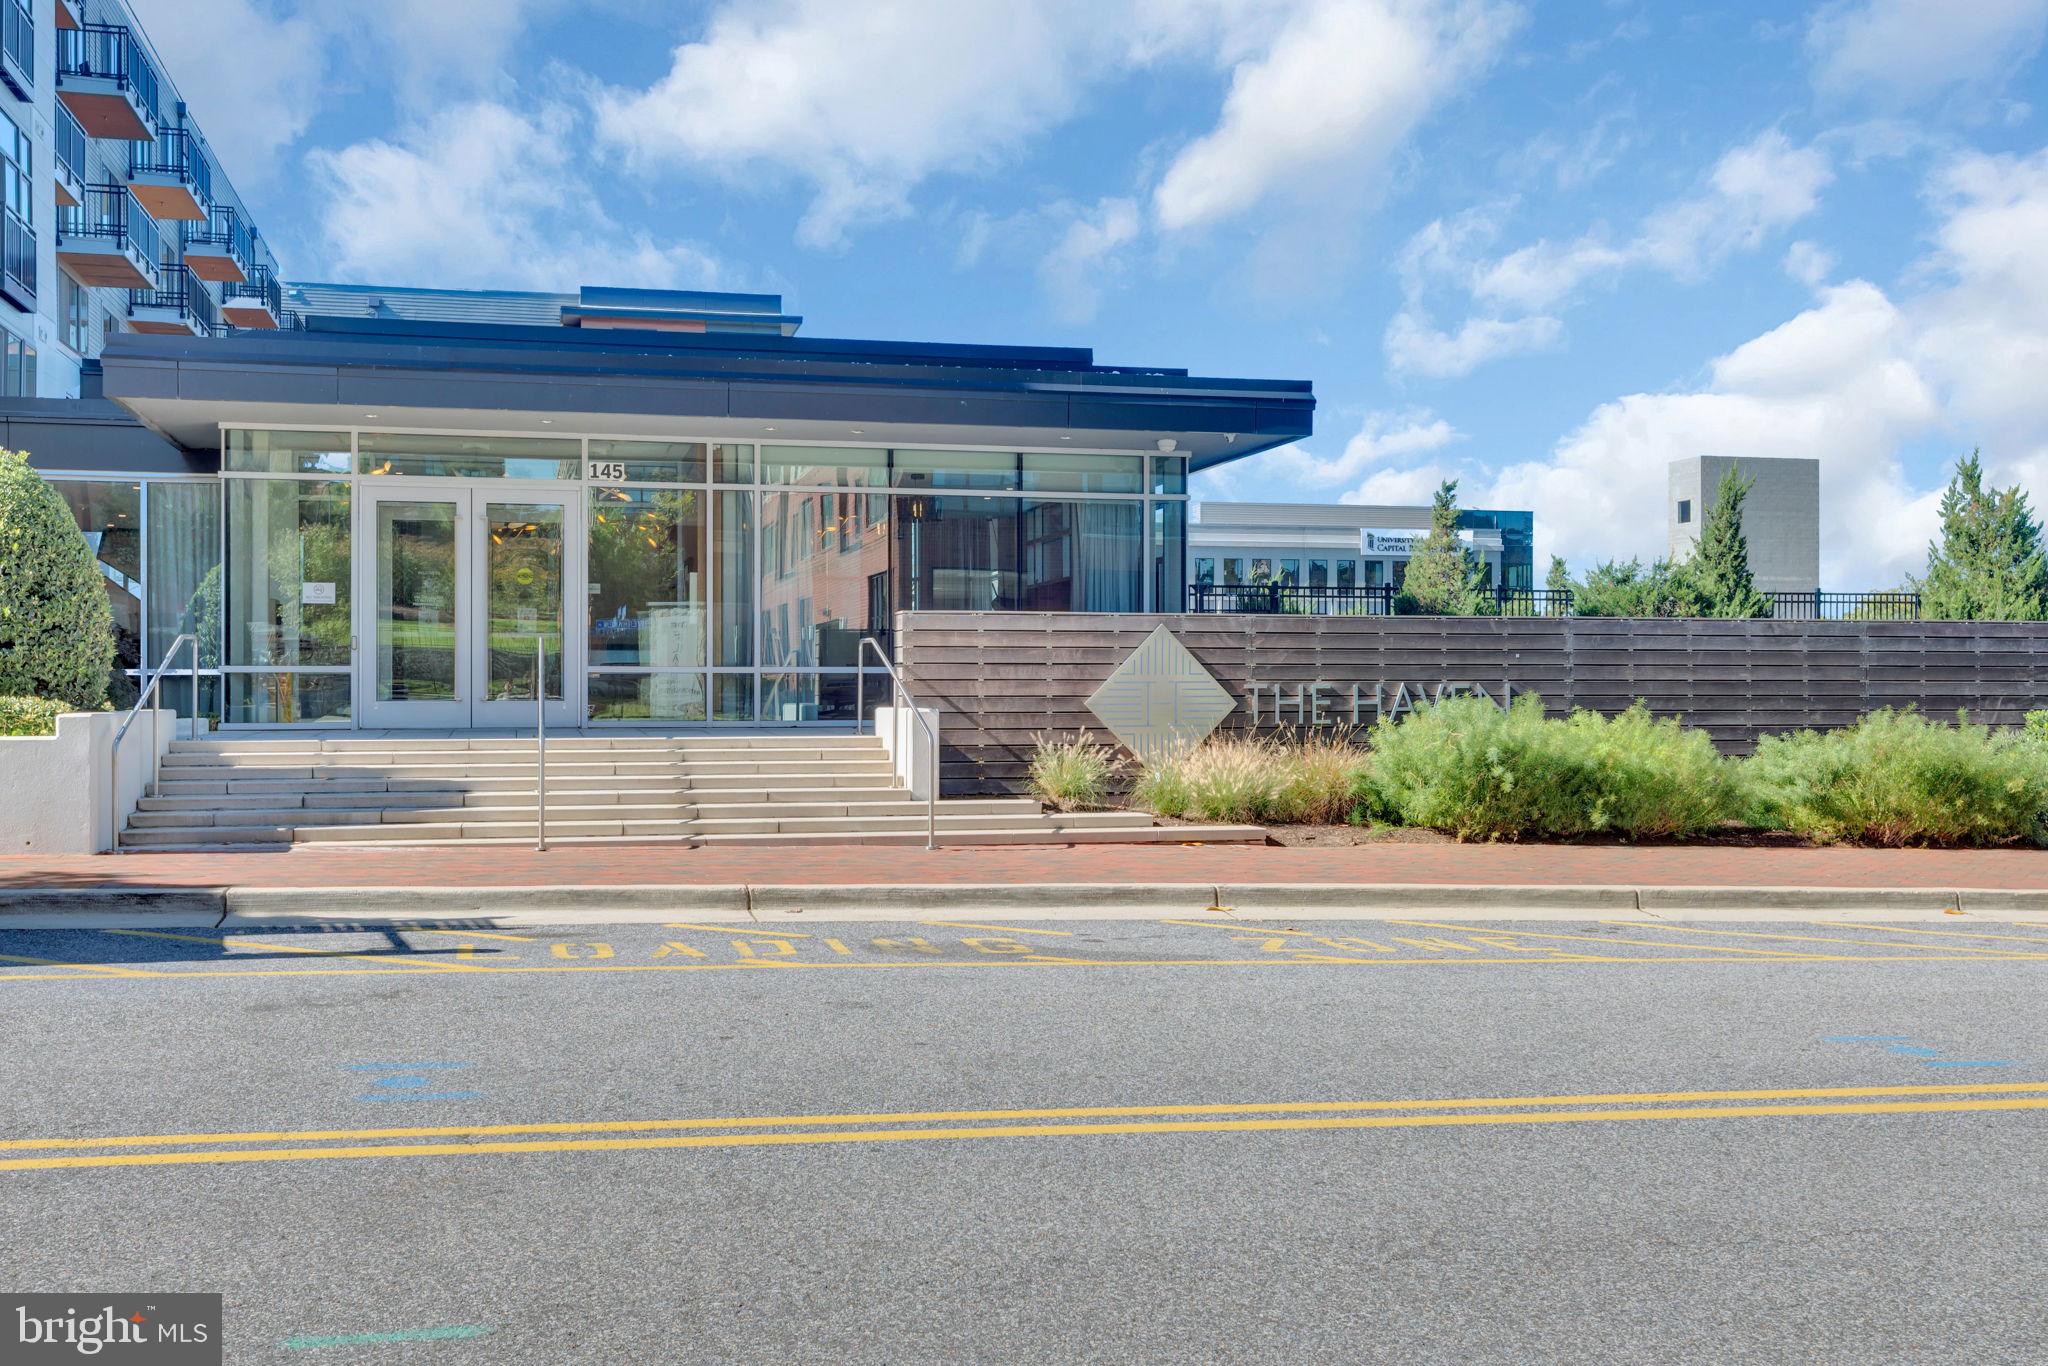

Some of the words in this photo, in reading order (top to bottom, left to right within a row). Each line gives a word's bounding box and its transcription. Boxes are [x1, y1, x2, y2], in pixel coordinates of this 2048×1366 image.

[590, 463, 623, 479] 145
[1377, 544, 1407, 552] CAPITAL
[1244, 683, 1332, 724] THE
